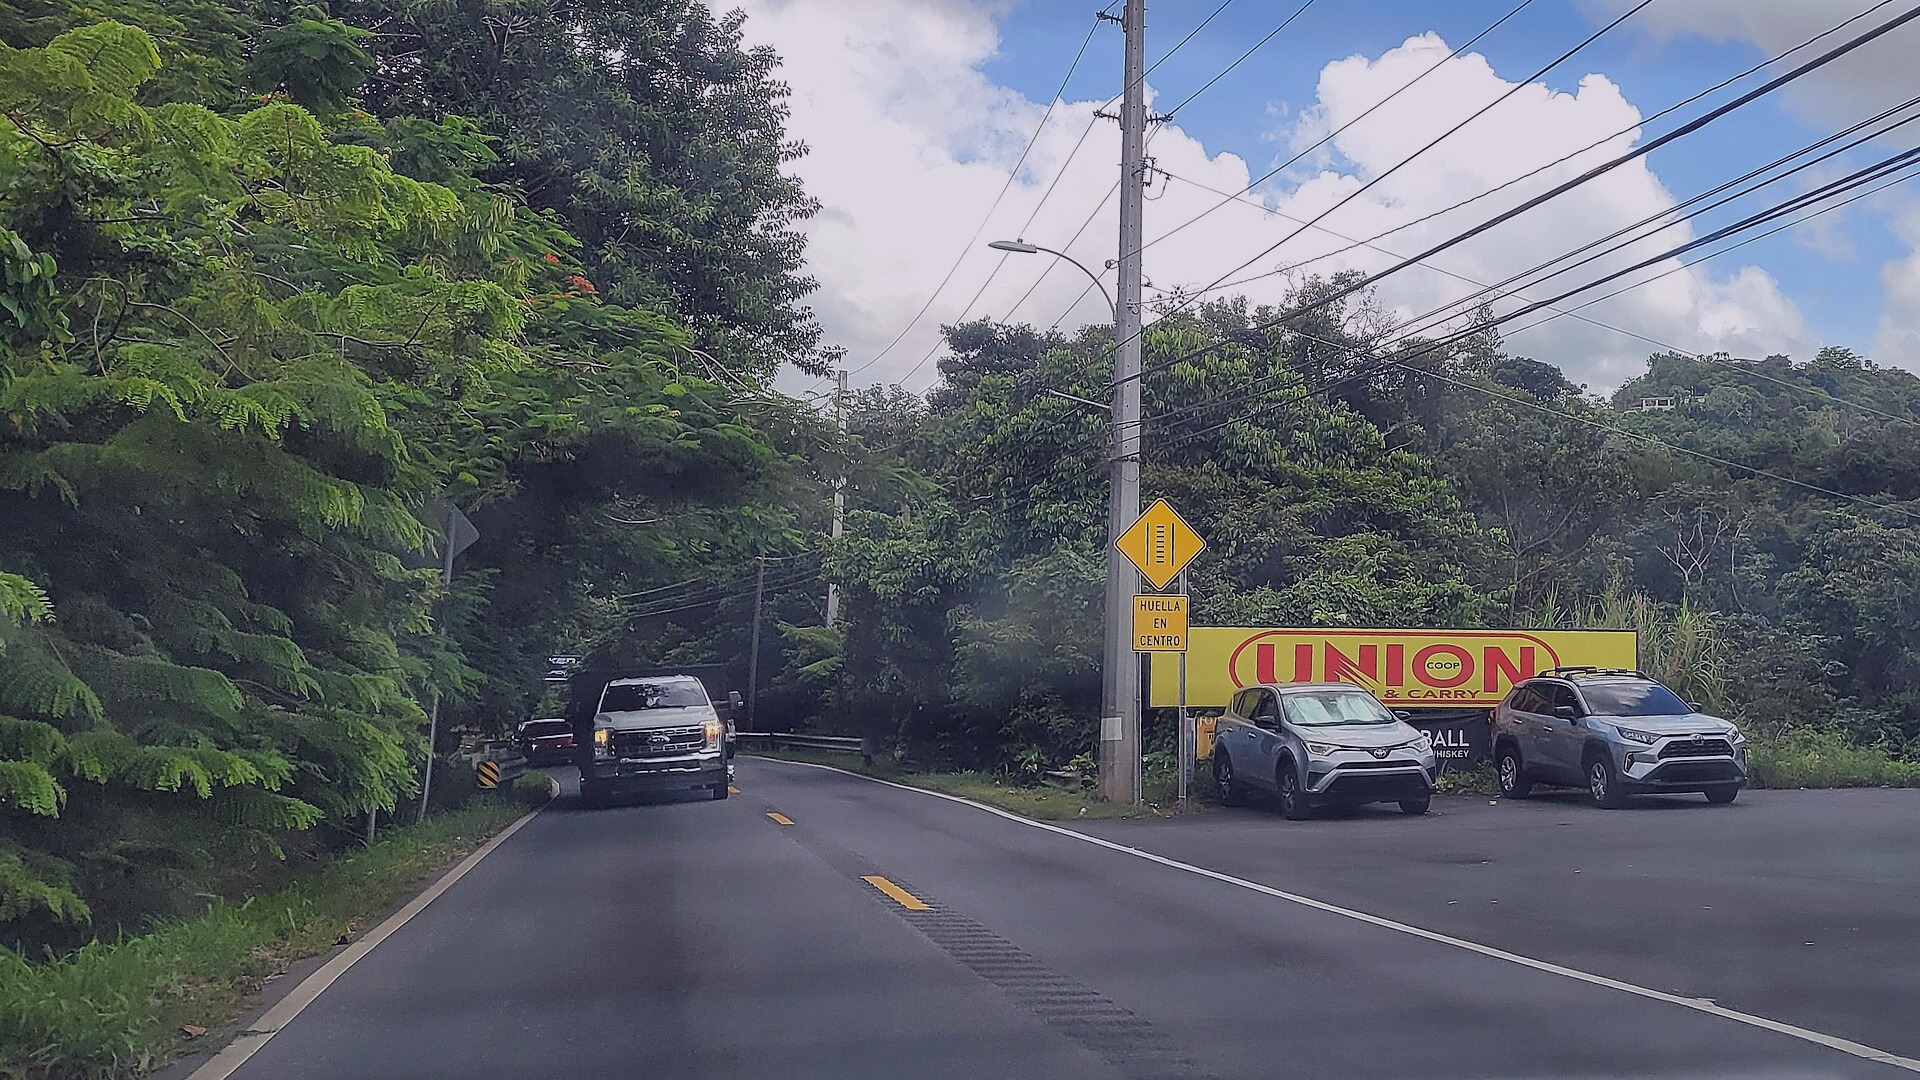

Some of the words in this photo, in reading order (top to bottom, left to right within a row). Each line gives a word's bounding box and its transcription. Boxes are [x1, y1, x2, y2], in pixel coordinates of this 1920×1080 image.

[1140, 600, 1181, 612] HUELLA
[1153, 617, 1167, 629] EN
[1140, 635, 1180, 647] CENTRO
[1257, 640, 1535, 693] UNION
[1426, 661, 1460, 670] COOP
[1384, 689, 1400, 699] &
[1407, 689, 1481, 699] CARRY
